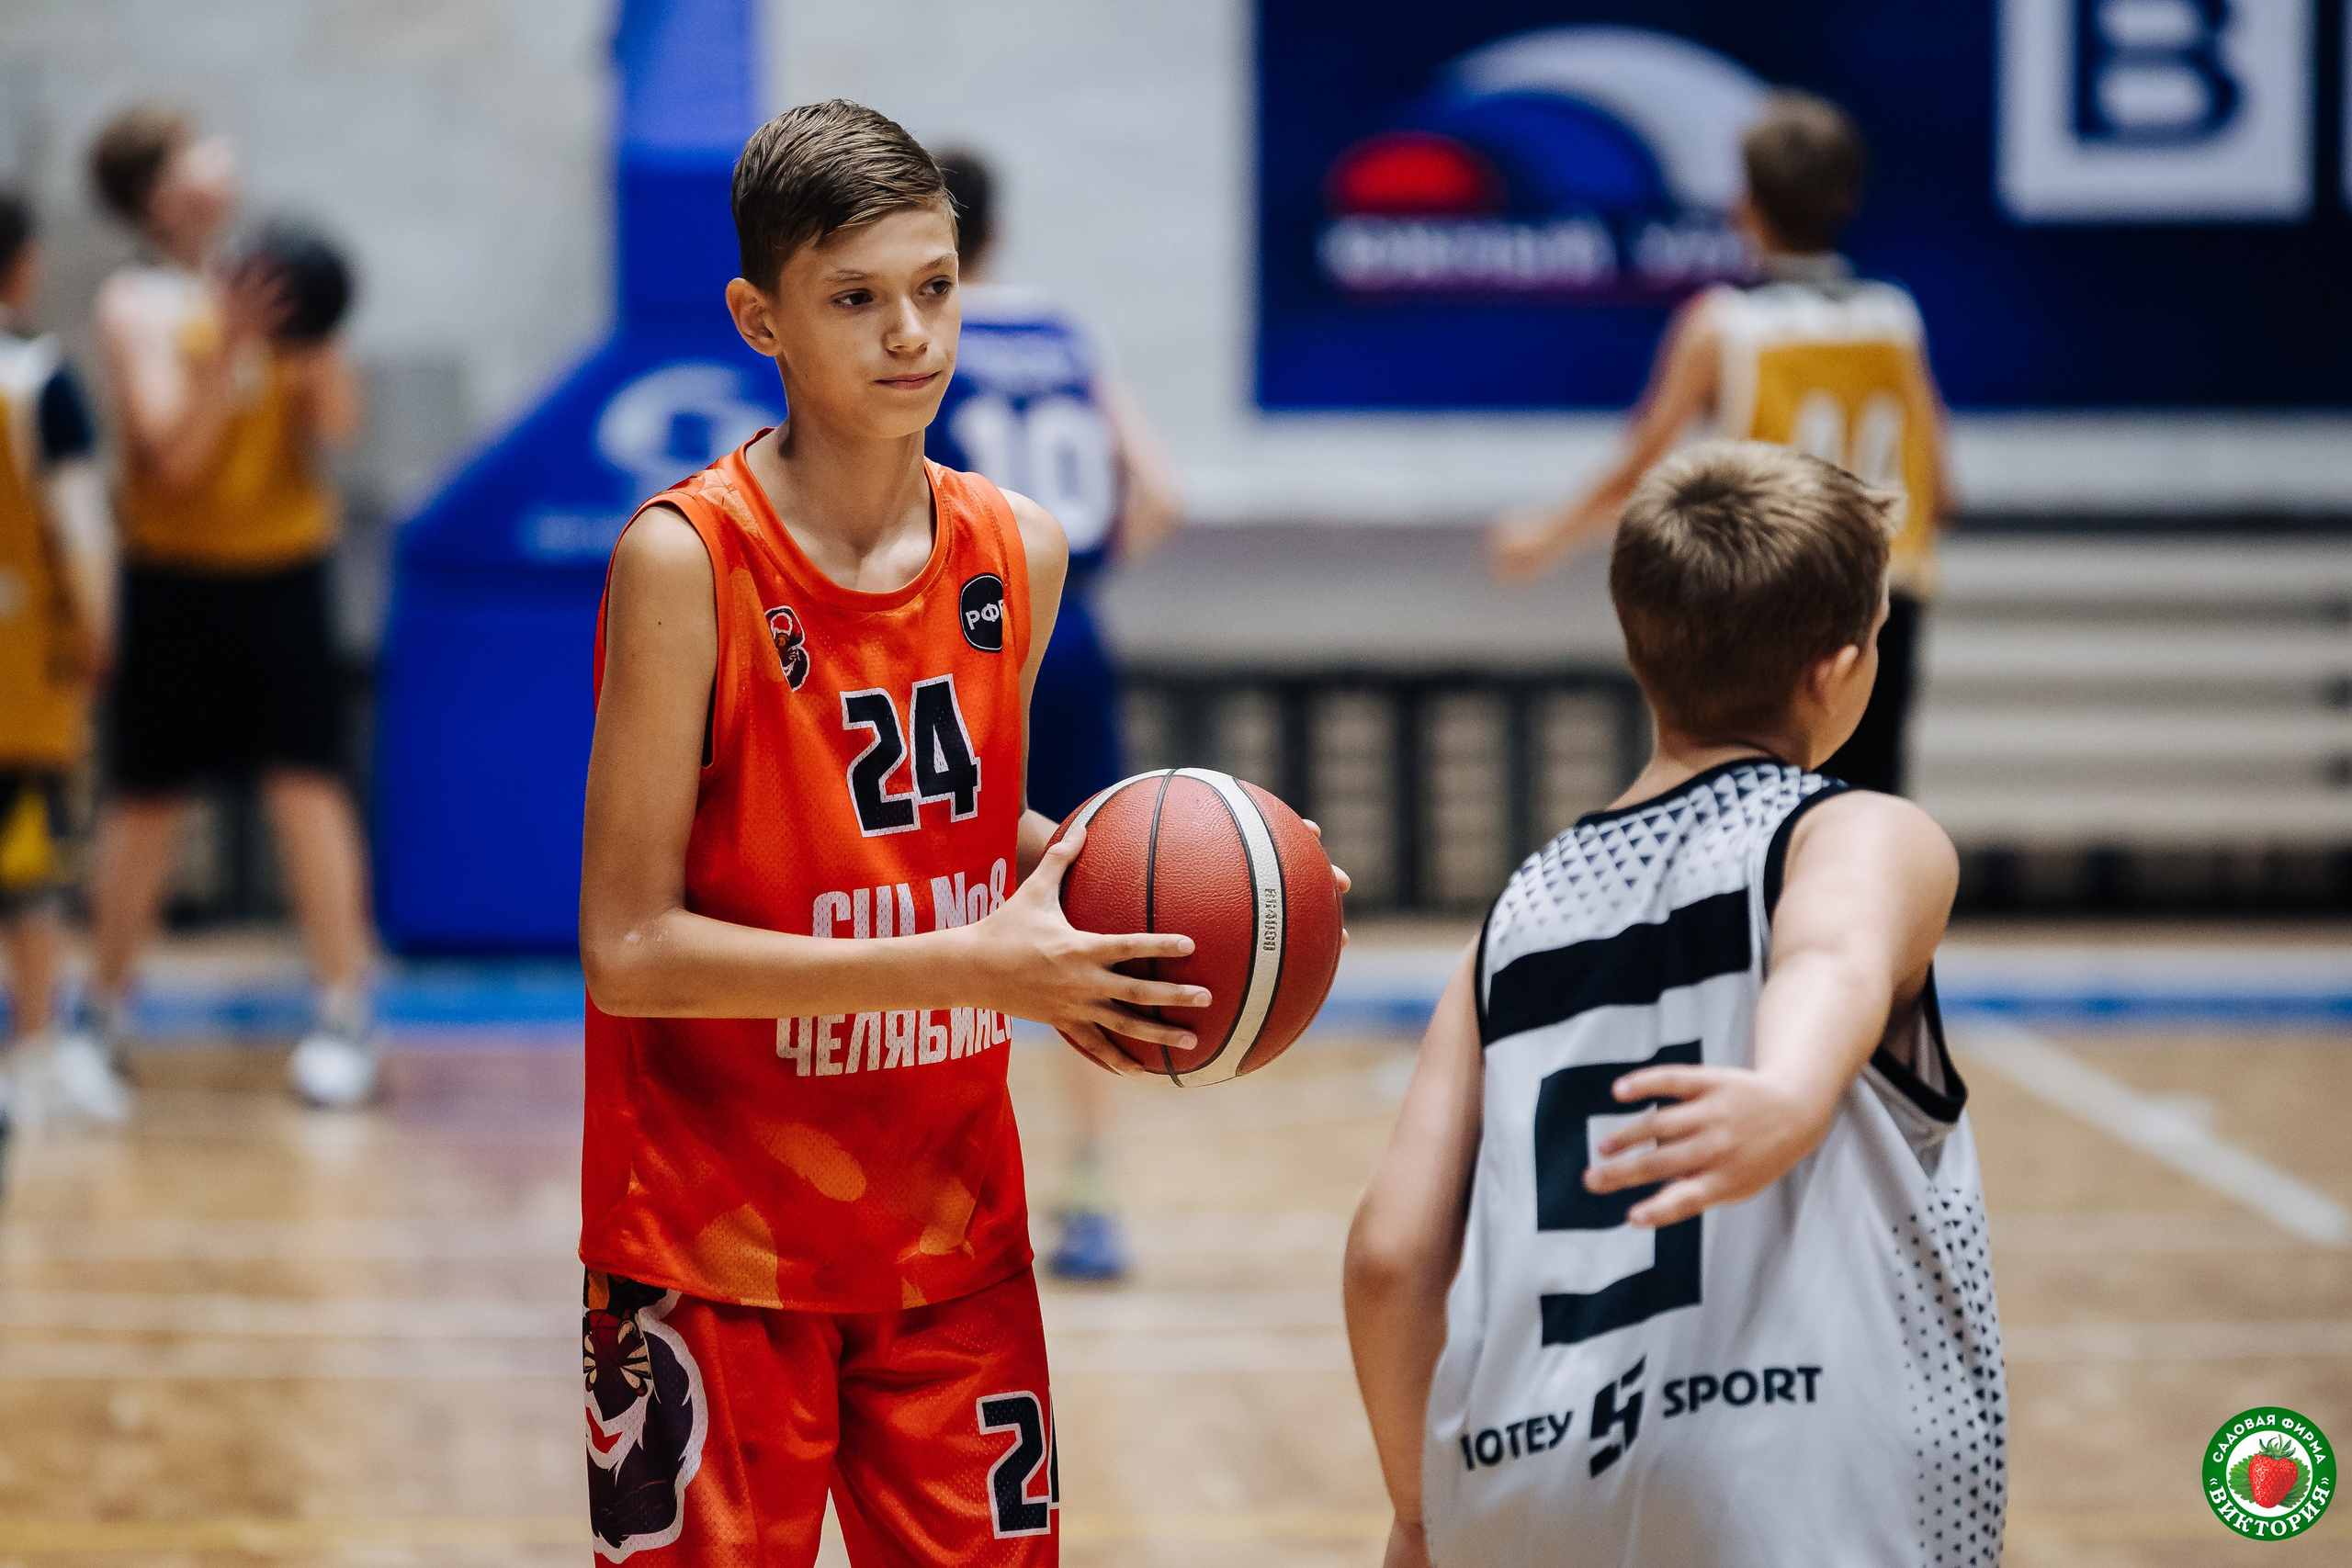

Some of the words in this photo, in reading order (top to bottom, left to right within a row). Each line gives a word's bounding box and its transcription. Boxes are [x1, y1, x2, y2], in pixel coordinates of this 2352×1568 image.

[840, 673, 981, 837] 24
[775, 1007, 1012, 1077] ЧЕЛЯБИНС
[1663, 1367, 1823, 1417] SPORT
[976, 1390, 1059, 1540] 2
